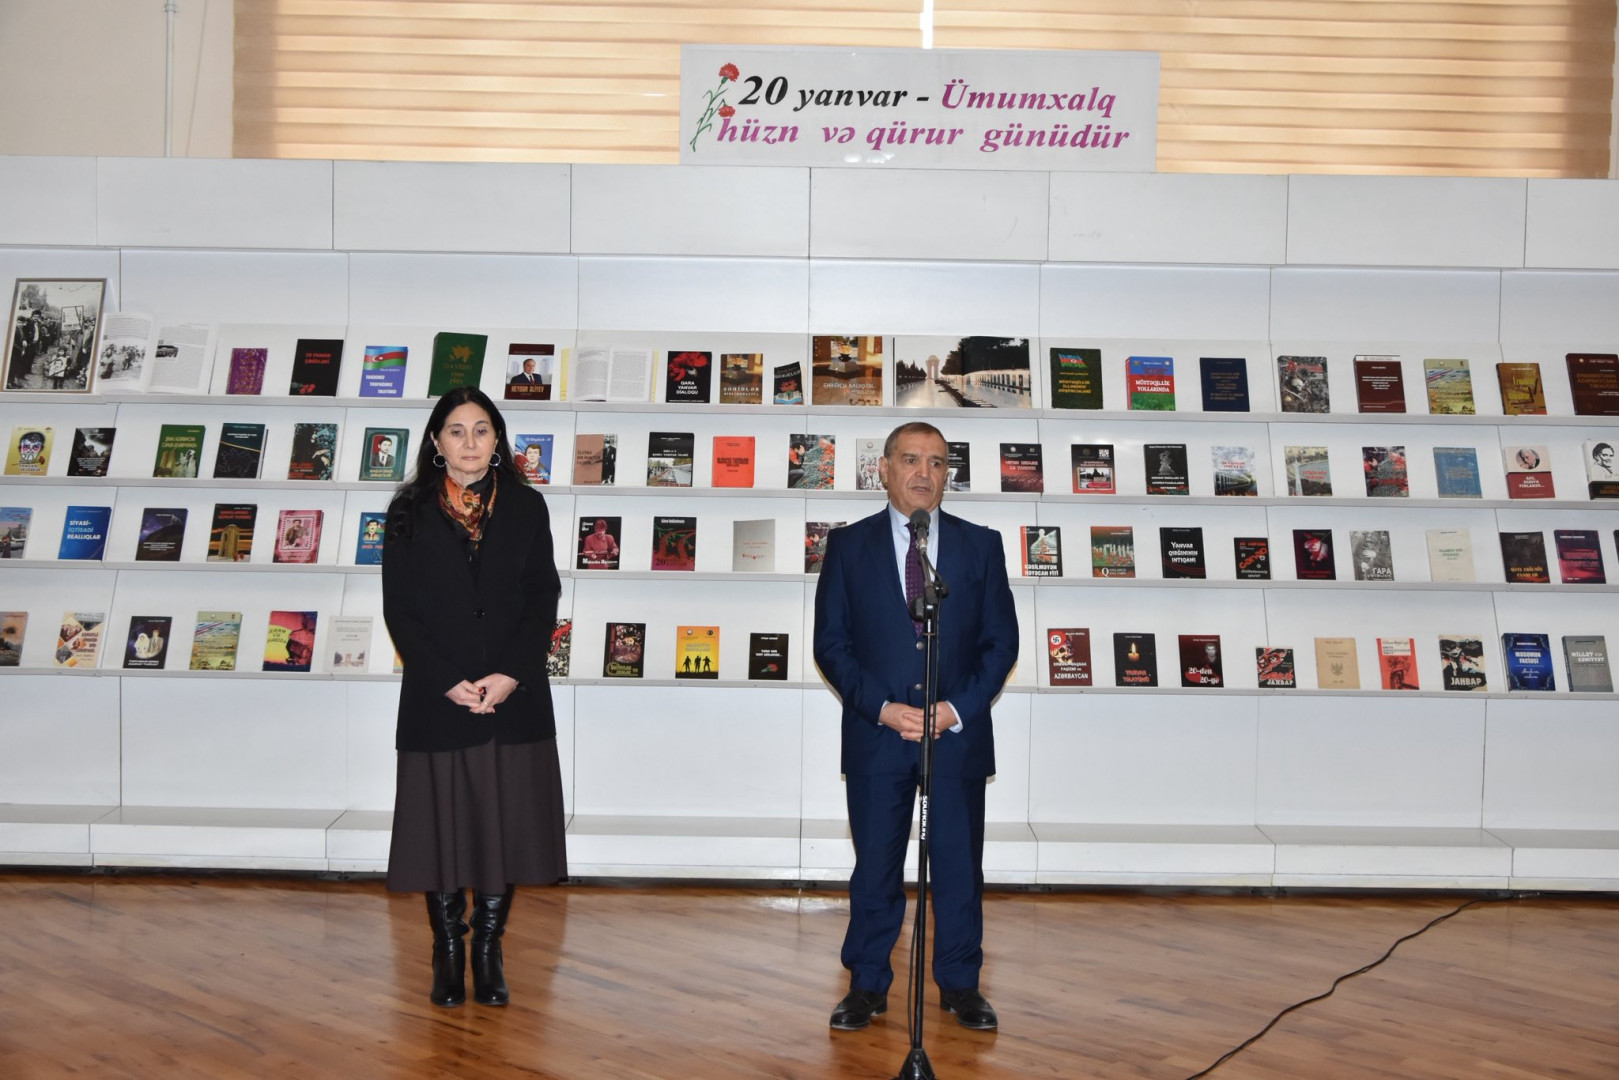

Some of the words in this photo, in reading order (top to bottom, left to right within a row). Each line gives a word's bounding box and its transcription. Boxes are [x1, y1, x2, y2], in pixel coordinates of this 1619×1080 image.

[737, 75, 789, 106] 20
[794, 88, 908, 111] yanvar
[941, 79, 1117, 118] Ümumxalq
[716, 117, 800, 144] hüzn
[821, 124, 856, 144] və
[866, 120, 965, 152] qürur
[979, 123, 1130, 153] günüdür
